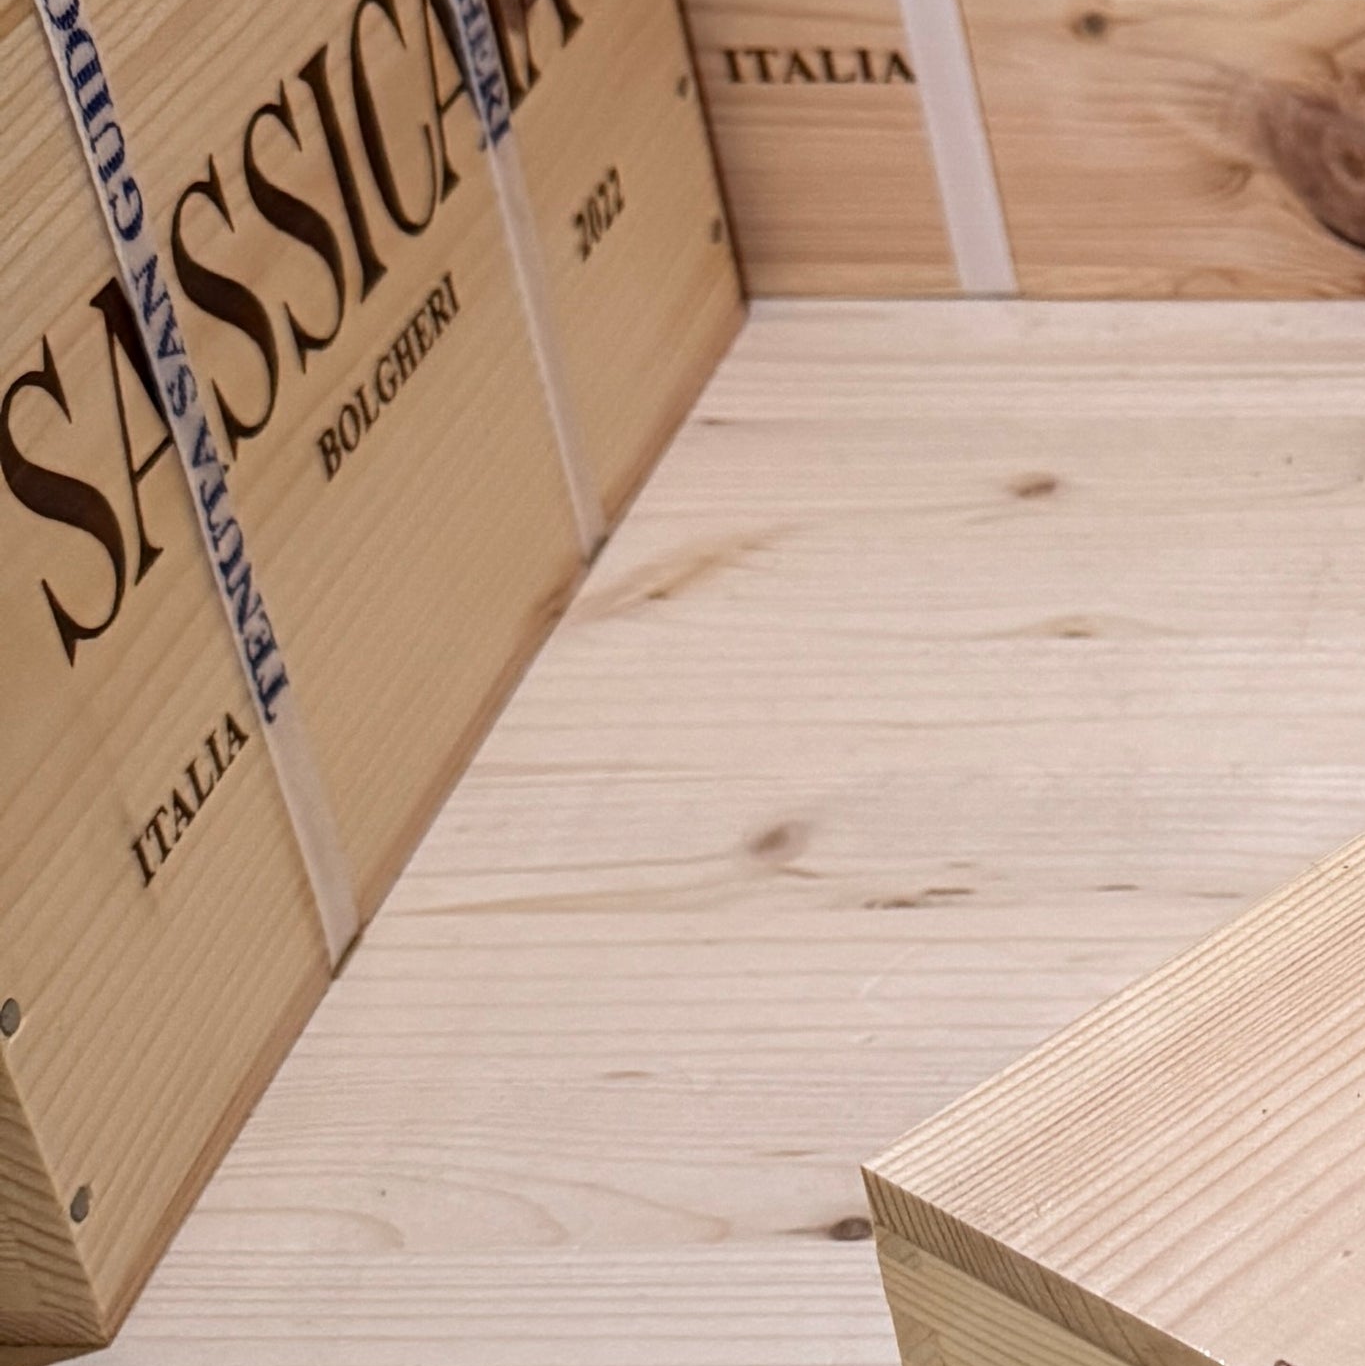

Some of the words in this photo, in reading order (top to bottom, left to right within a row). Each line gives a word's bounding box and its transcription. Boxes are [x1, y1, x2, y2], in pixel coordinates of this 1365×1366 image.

[722, 46, 916, 85] ITALIA
[571, 166, 625, 263] 2022
[130, 253, 201, 419] SAN
[315, 272, 462, 483] BOLGHERI
[189, 415, 291, 725] TENUTA
[130, 711, 250, 888] ITALIA
